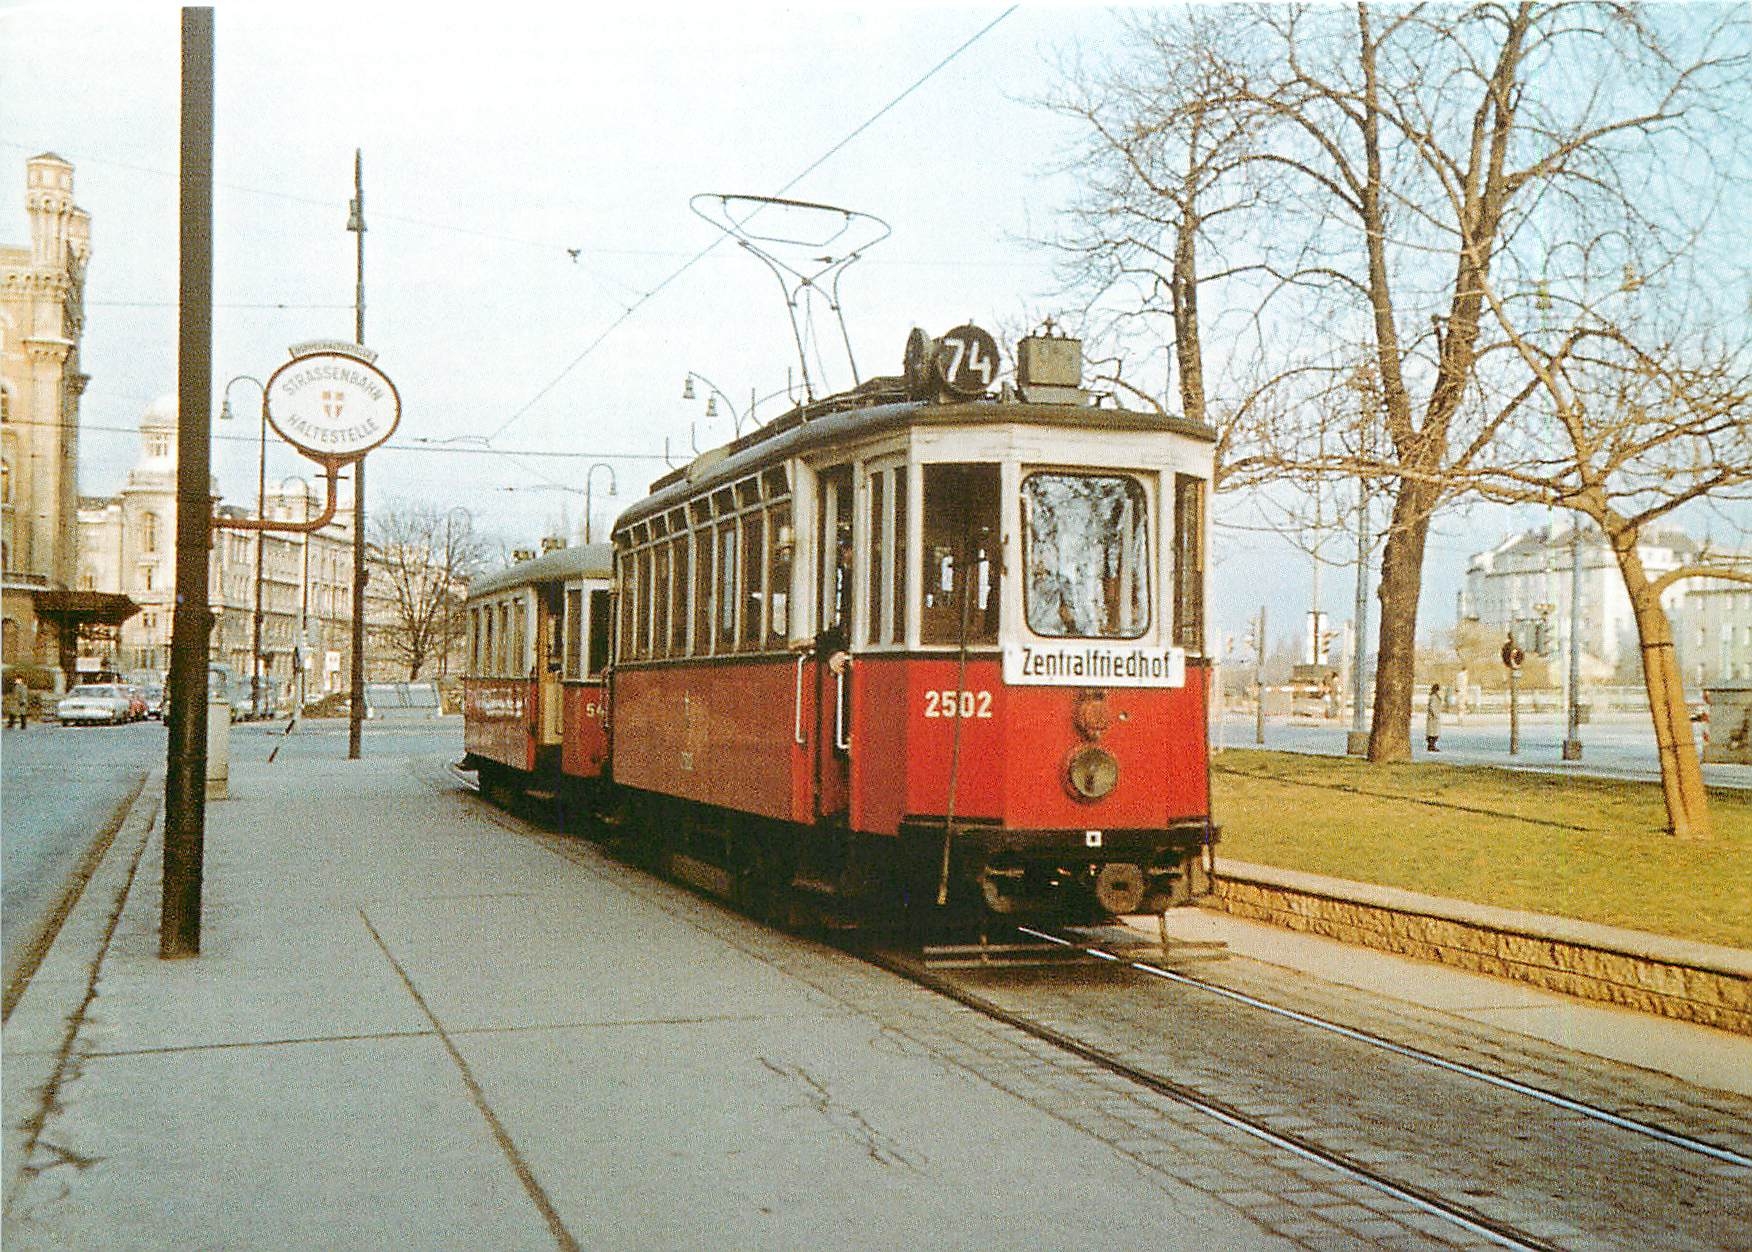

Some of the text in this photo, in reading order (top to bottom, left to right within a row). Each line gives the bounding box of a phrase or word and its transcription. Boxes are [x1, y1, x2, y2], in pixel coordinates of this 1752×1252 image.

[944, 338, 991, 384] 74
[282, 365, 385, 401] STRASSENBAHN
[287, 413, 380, 444] HALTESTELLE
[1023, 648, 1171, 678] Zentralfriedhof
[924, 690, 992, 719] 2502
